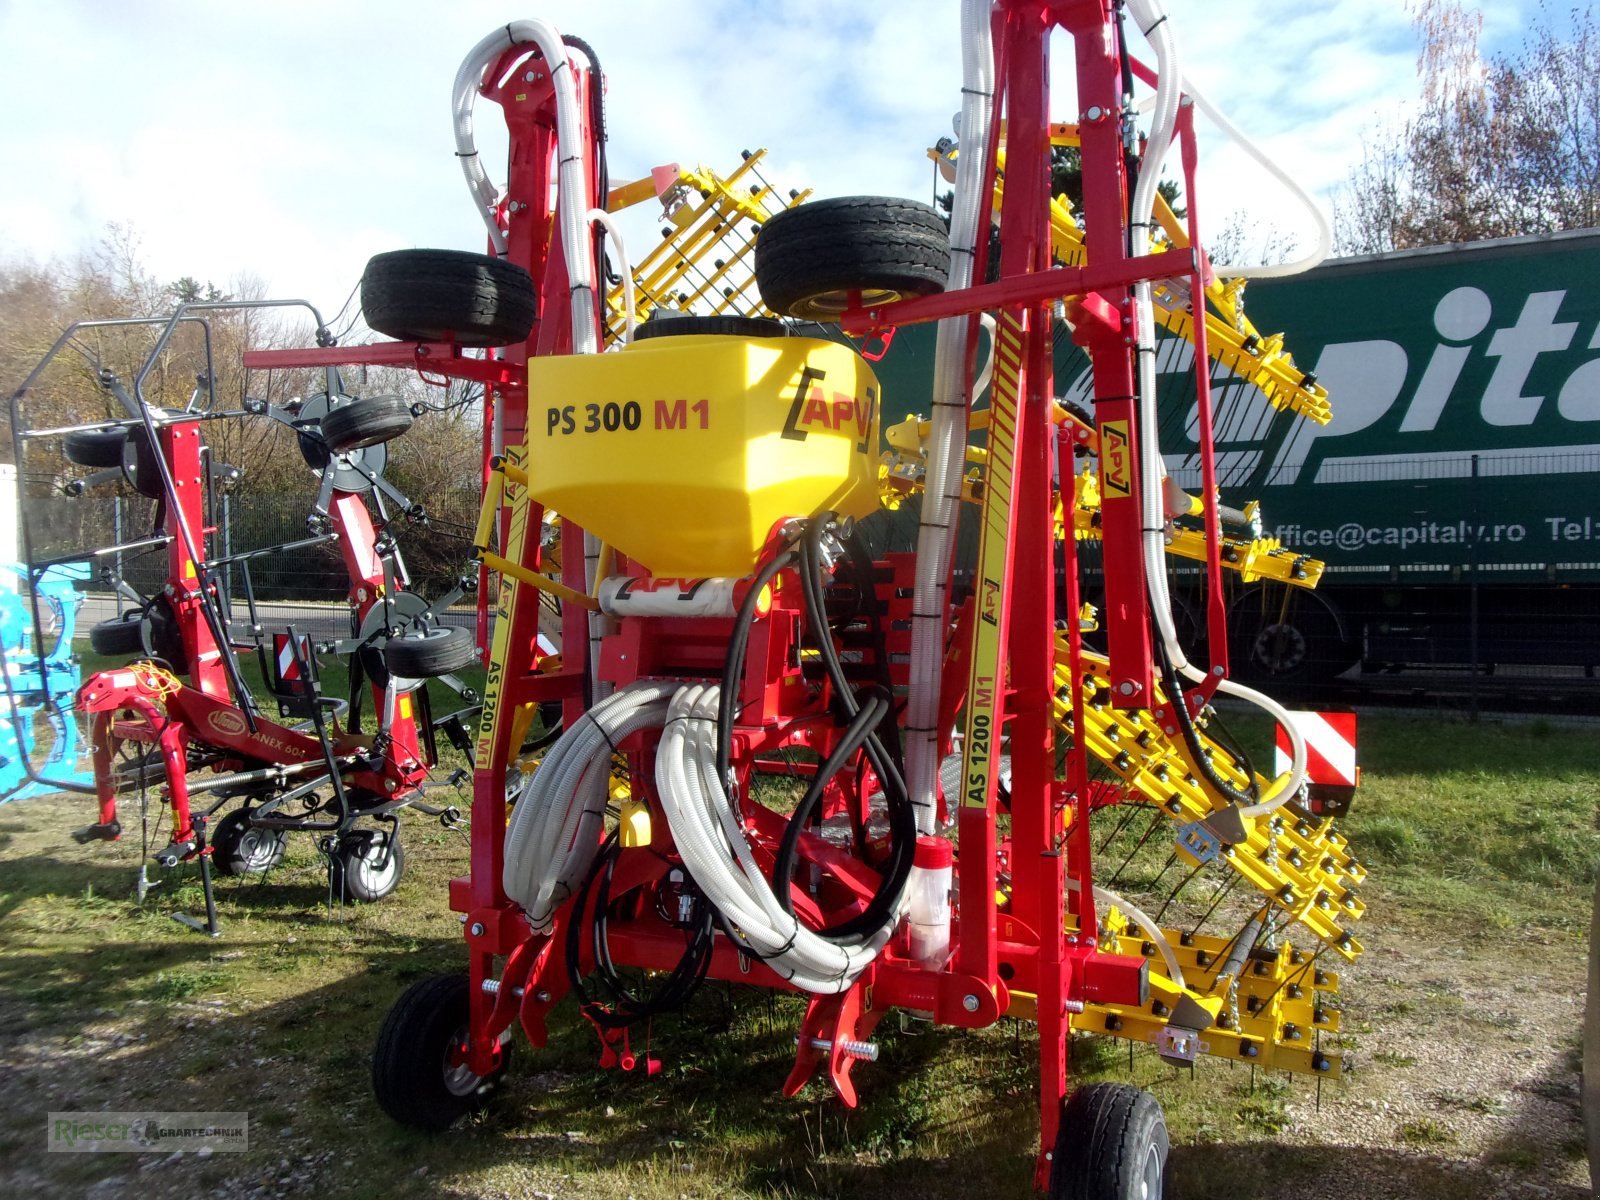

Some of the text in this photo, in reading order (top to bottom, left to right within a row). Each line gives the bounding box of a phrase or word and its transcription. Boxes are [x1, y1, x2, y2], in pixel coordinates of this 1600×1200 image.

[547, 399, 709, 437] PS 300 M1
[247, 731, 284, 750] ANEX
[476, 660, 502, 766] AS 1200 M1
[968, 676, 993, 804] AS 1200 M1
